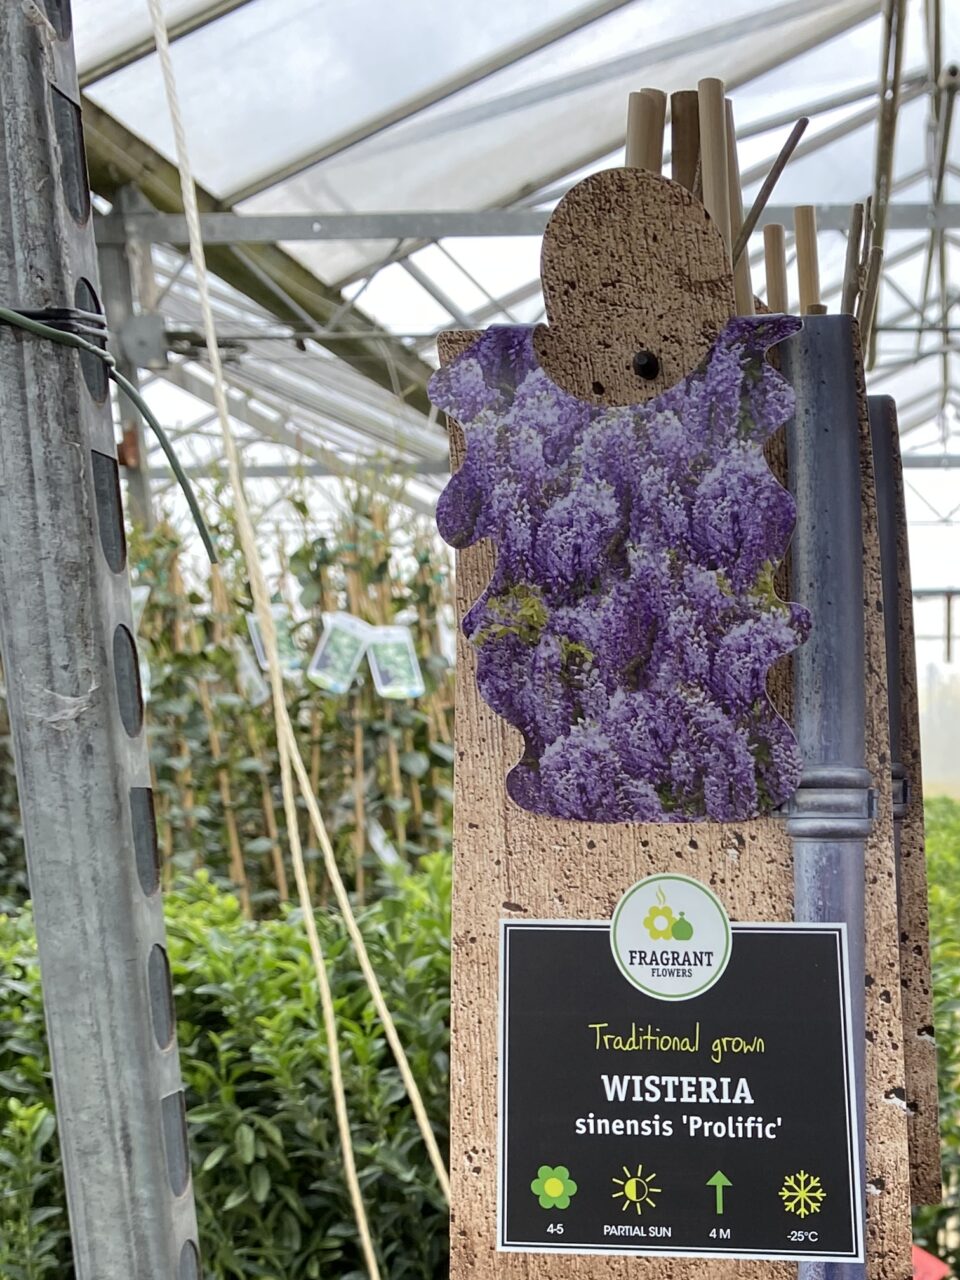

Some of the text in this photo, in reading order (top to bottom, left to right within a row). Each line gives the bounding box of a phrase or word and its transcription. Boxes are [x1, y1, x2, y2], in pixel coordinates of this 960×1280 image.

[628, 950, 714, 968] FRAGRANT
[651, 967, 693, 978] FLOWERS
[588, 1021, 765, 1064] Traditional grown
[600, 1074, 755, 1105] WISTERIA
[575, 1112, 783, 1140] sinensis 'Prolific'
[546, 1223, 565, 1235] 4-5
[603, 1224, 672, 1238] PARTIAL SUN
[708, 1227, 731, 1240] 4 M
